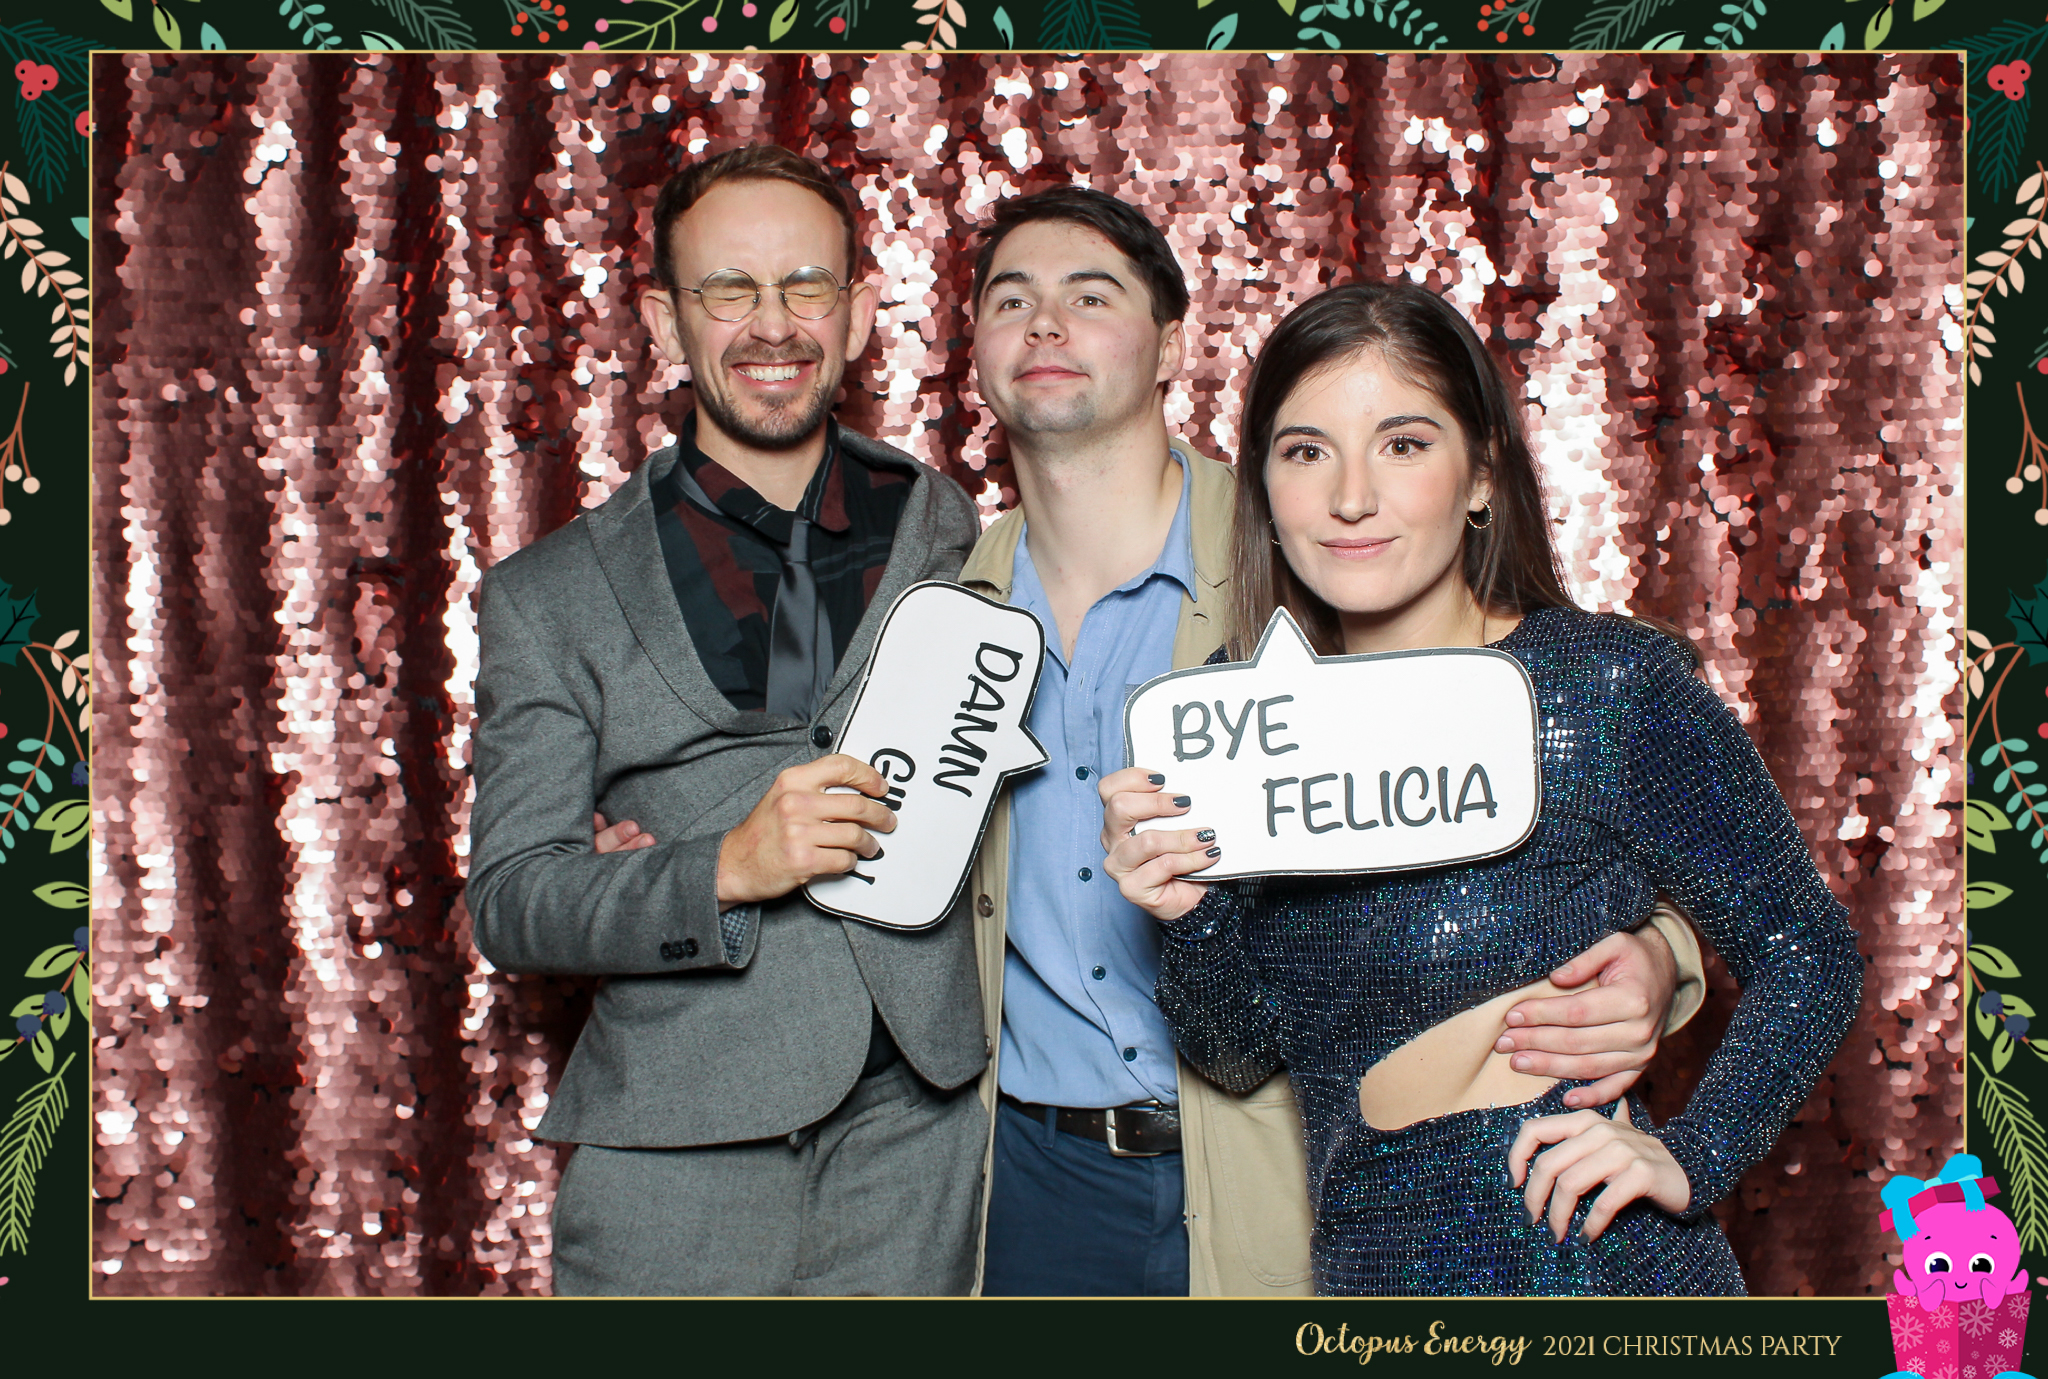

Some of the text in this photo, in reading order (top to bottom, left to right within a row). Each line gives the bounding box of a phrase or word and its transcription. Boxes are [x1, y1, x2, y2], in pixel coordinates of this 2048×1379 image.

[933, 642, 1023, 797] DAMN
[1173, 695, 1299, 761] BYE
[1262, 763, 1498, 837] FELICIA
